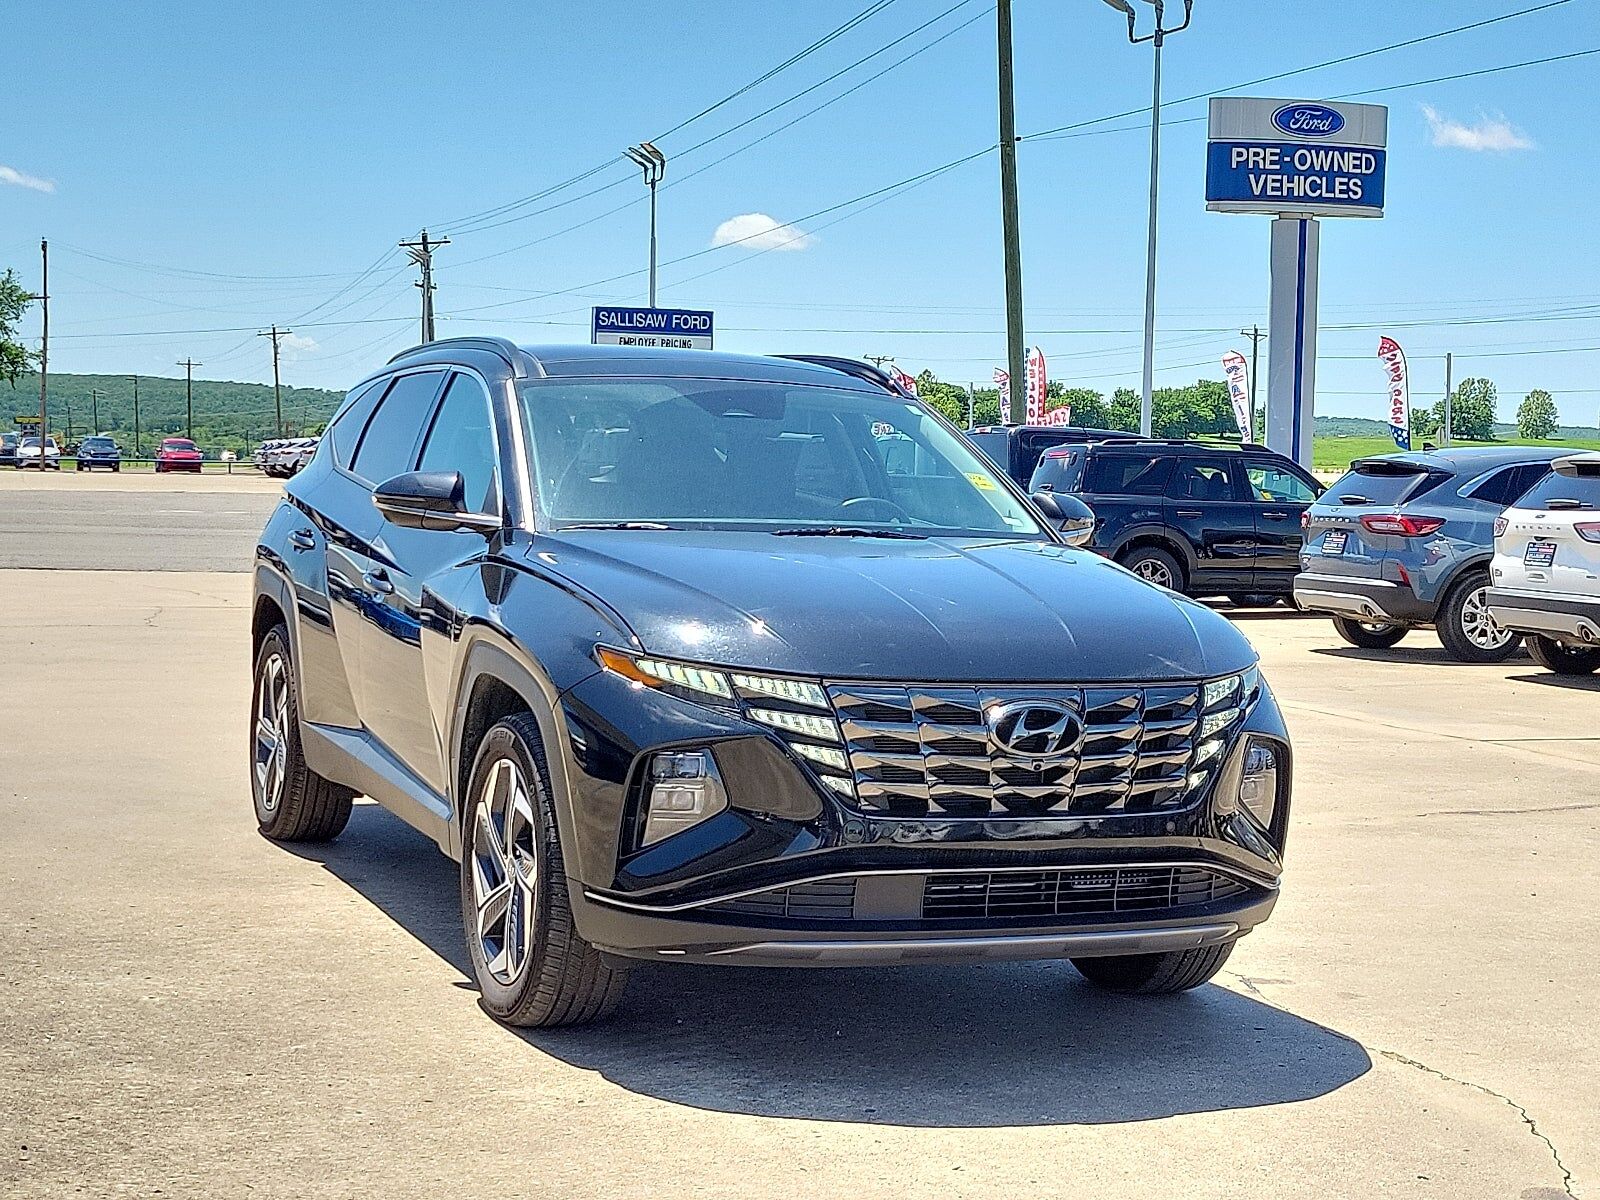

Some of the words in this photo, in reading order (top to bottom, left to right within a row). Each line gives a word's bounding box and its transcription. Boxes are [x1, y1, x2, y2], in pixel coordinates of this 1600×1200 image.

[1289, 109, 1333, 131] Ford
[1231, 147, 1376, 174] PRE-OWNED
[1248, 173, 1363, 200] VEHICLES
[598, 311, 667, 328] SALLISAW
[672, 314, 710, 330] FORD
